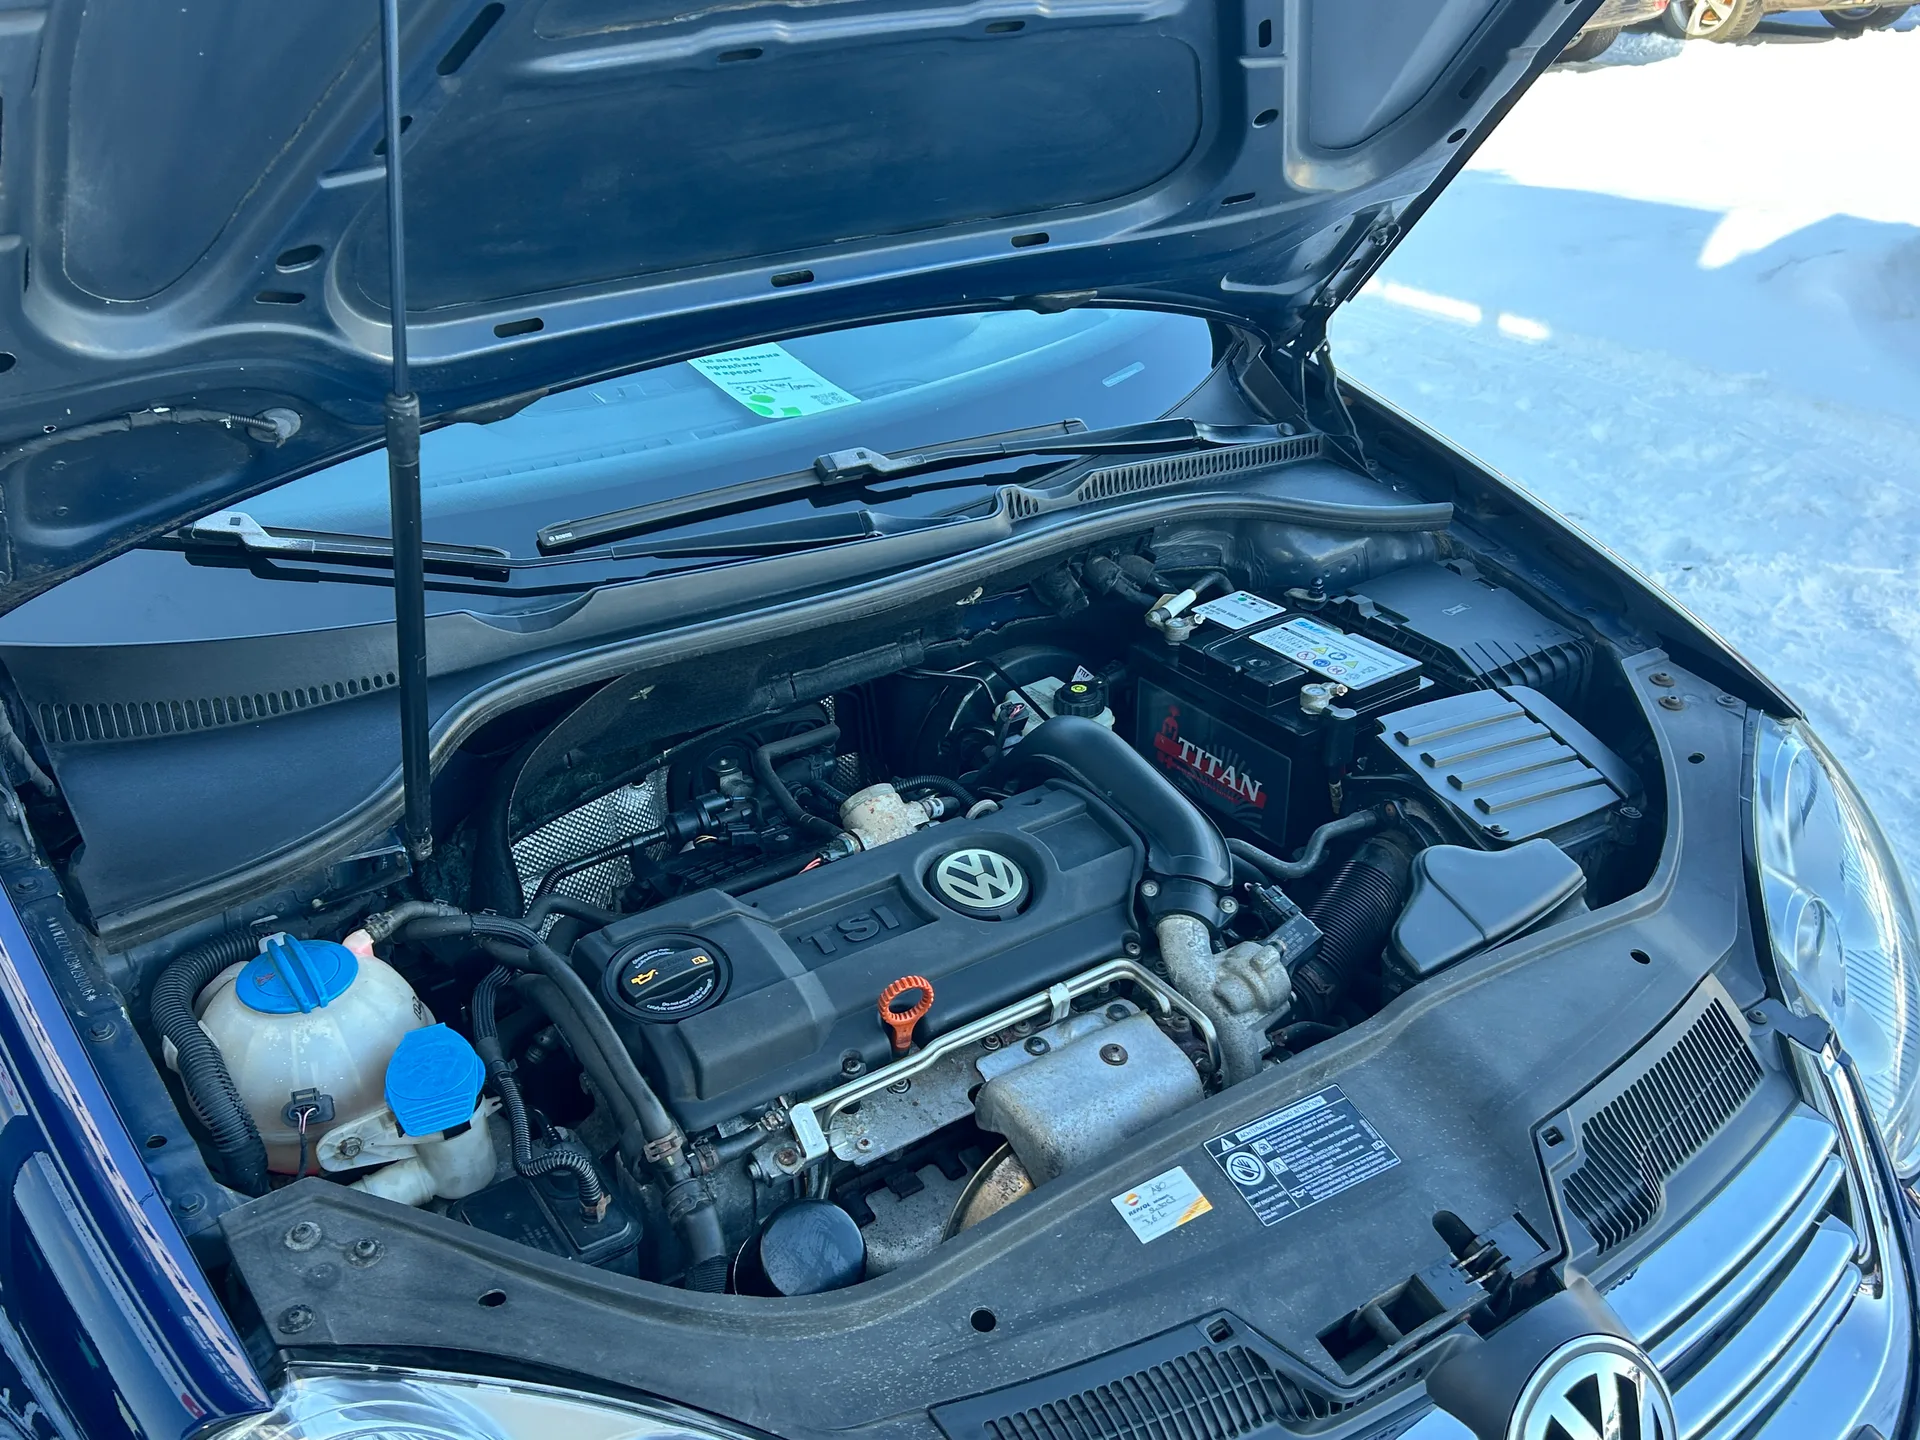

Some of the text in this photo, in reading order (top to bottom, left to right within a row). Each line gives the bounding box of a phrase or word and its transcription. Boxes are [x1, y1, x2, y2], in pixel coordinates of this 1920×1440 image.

[1177, 736, 1263, 802] TITAN
[797, 905, 900, 955] TSI
[1128, 1202, 1151, 1216] REPSOL
